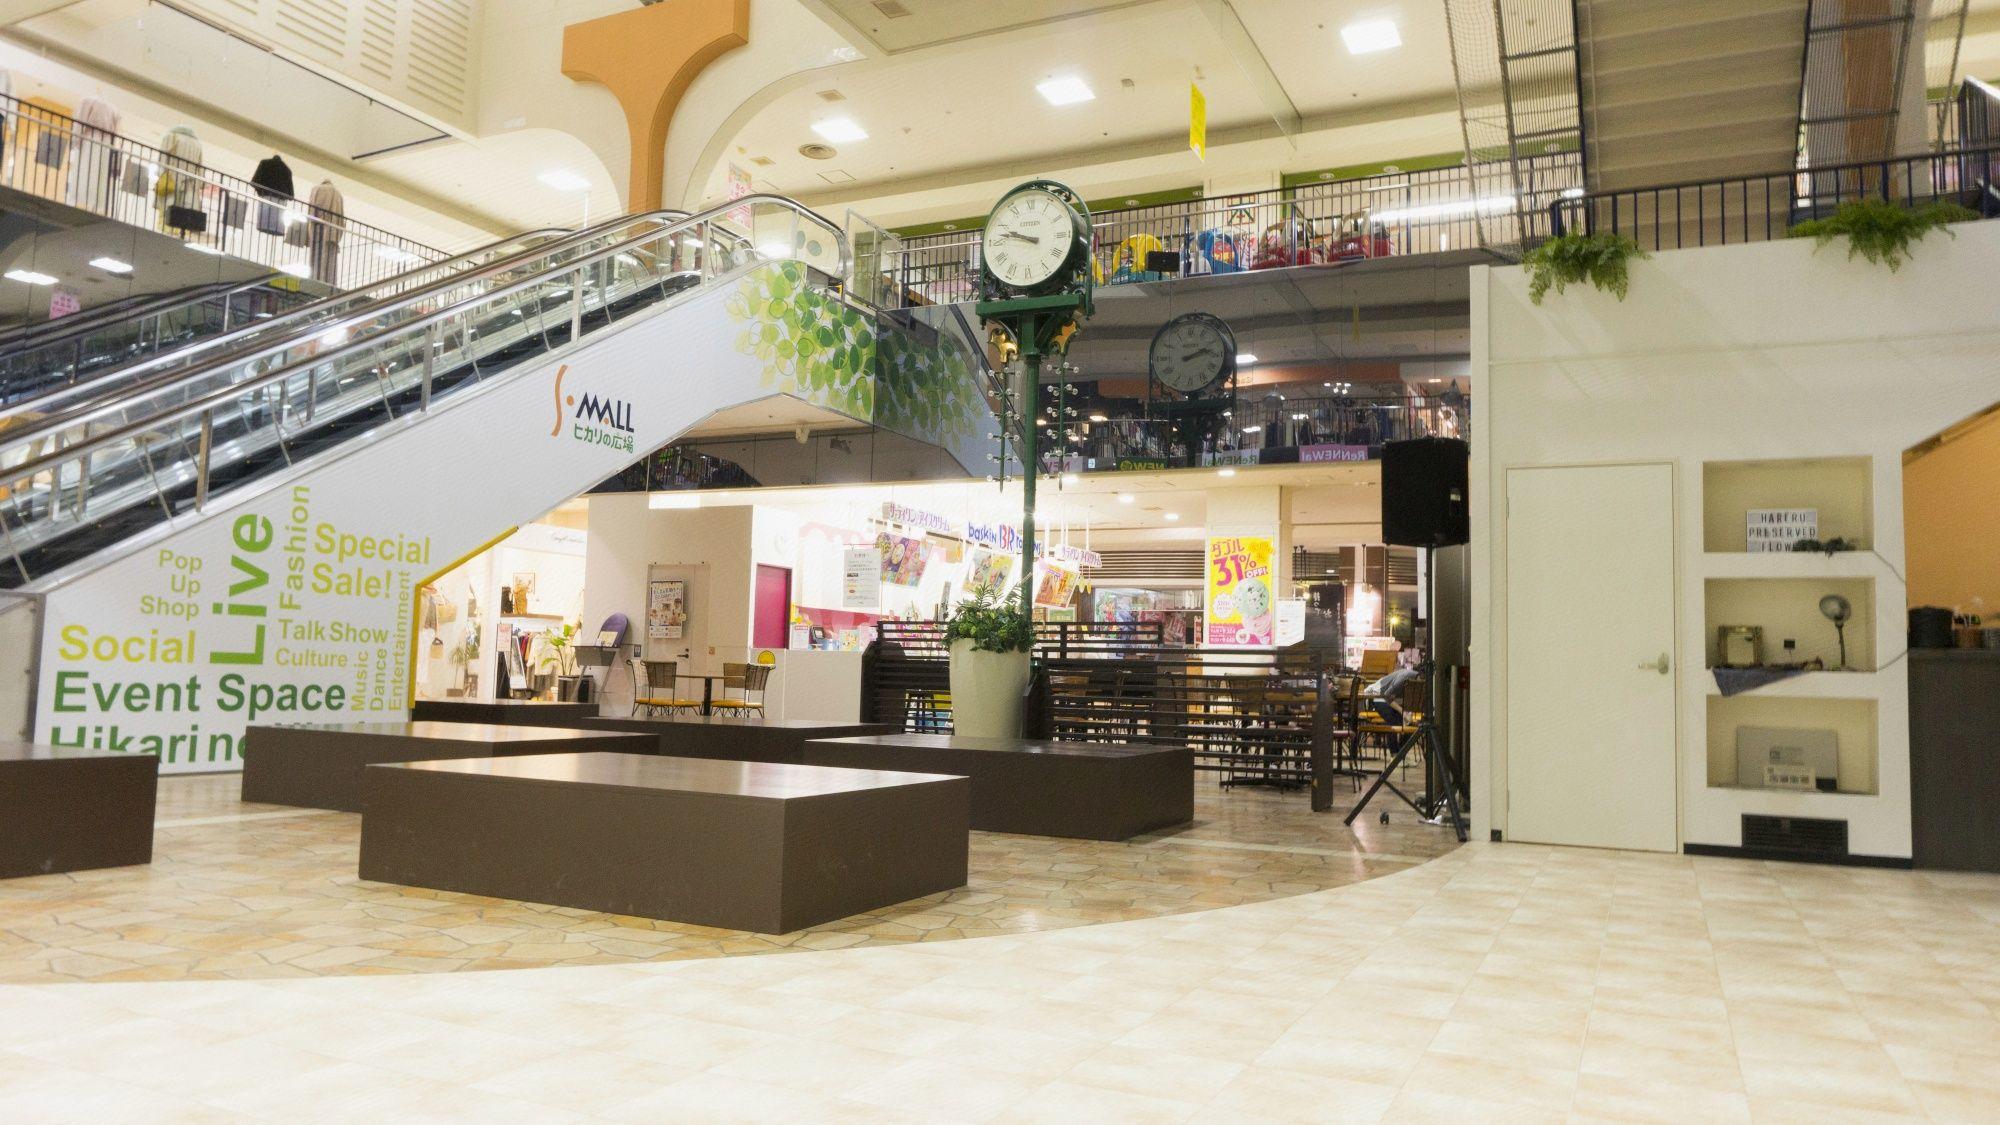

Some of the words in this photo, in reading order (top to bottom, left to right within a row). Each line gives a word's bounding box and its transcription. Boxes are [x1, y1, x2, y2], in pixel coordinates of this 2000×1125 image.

[573, 422, 635, 454] ヒカリの広場
[279, 485, 310, 610] Fashion
[315, 522, 431, 565] Special
[1212, 539, 1245, 557] ダブル
[1748, 526, 1817, 538] PRESERVED
[1761, 541, 1793, 552] FLOW
[159, 549, 202, 572] Pop
[1245, 566, 1269, 580] OFF!
[170, 574, 201, 596] Up
[209, 513, 274, 665] Live
[311, 562, 393, 599] Sale!
[140, 595, 200, 622] Shop
[58, 624, 196, 664] Social
[274, 648, 349, 668] Culture
[388, 570, 411, 712] Entertainment
[53, 671, 201, 713] Event
[216, 673, 346, 720] Space
[350, 651, 370, 712] Music
[369, 648, 388, 712] Dance
